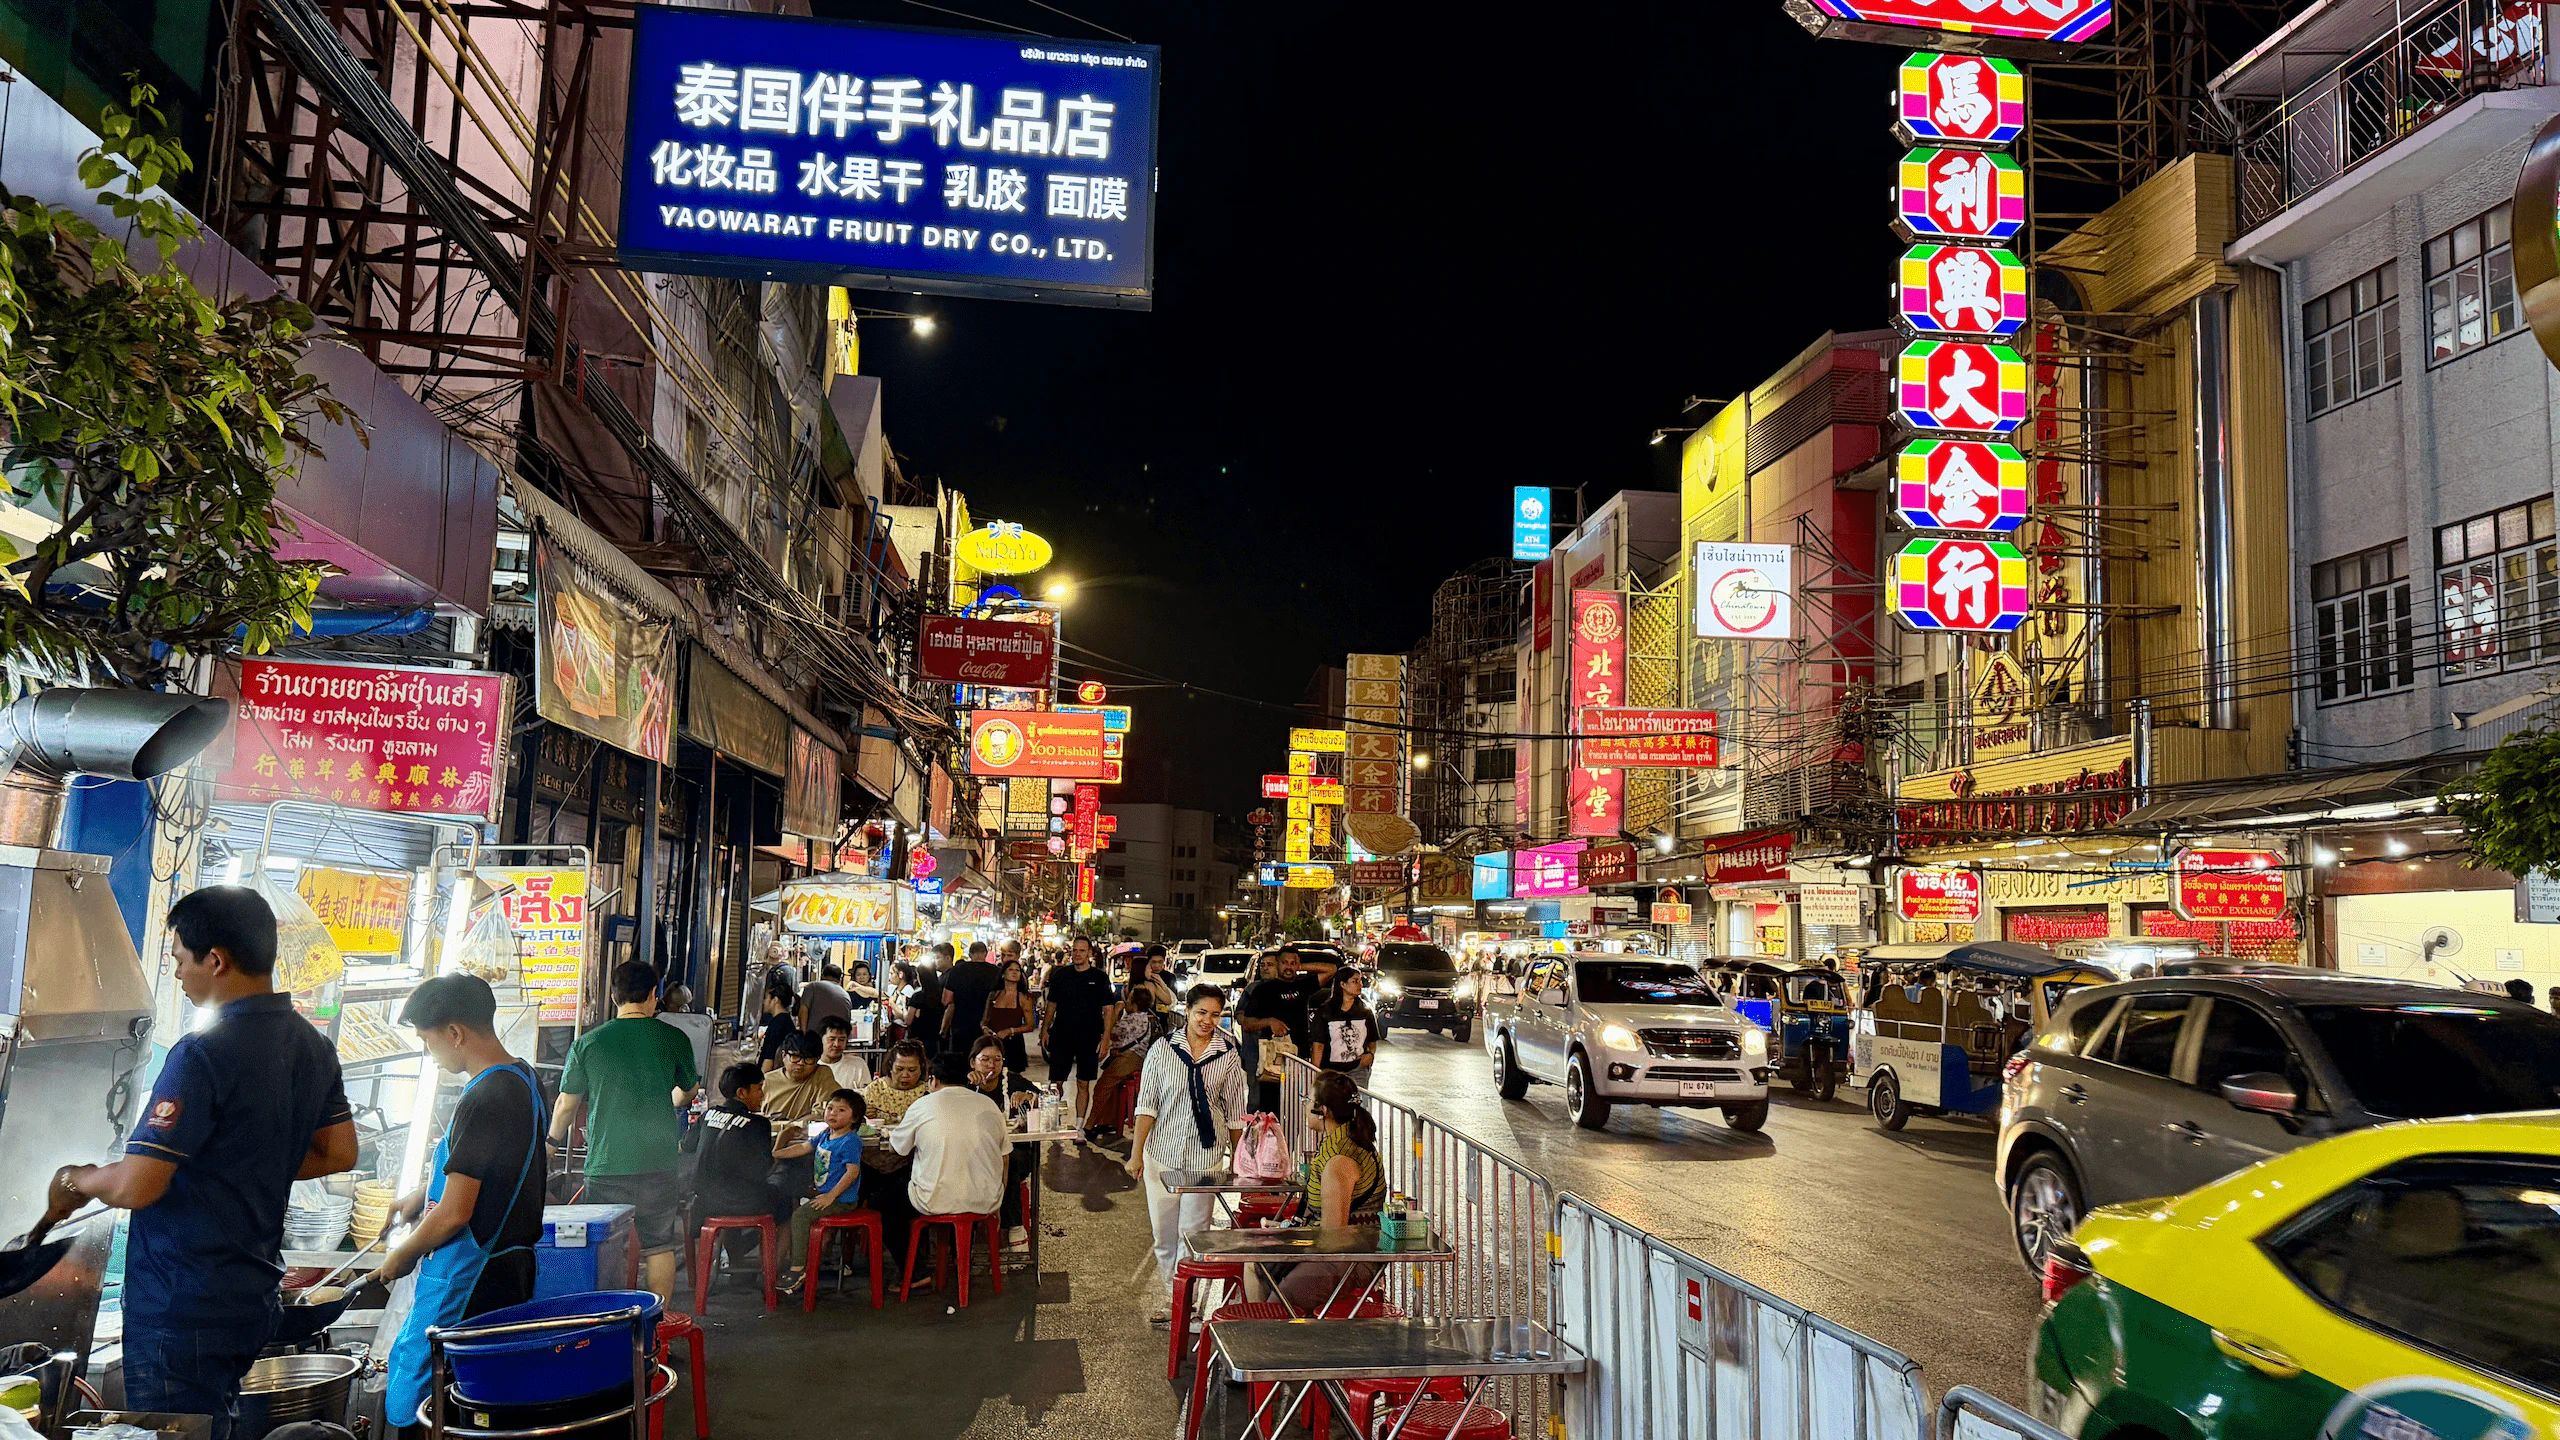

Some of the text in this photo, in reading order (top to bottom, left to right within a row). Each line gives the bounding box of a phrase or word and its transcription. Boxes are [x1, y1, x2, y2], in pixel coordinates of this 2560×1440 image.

[1021, 48, 1045, 60] บริษัท
[674, 62, 1115, 159] 泰国伴手礼品店
[650, 140, 1129, 222] 化妆品 水果干 乳胶 面膜
[660, 205, 1113, 261] YAOWARAT FRUIT DRY CO., LTD.
[1933, 61, 2000, 624] 馬利興大金行
[959, 661, 1010, 680] Coca-Cola
[312, 705, 431, 733] ยาสมุนไพรจีน
[436, 711, 469, 733] ต่าง
[280, 728, 313, 749] โสม
[324, 733, 374, 754] รังนก
[1586, 648, 1613, 819] 北京堂
[1057, 745, 1099, 757] Fishball
[2191, 905, 2277, 915] MONEY EXCHANGE
[521, 929, 581, 941] ฉลาม
[2065, 949, 2084, 957] TAXI
